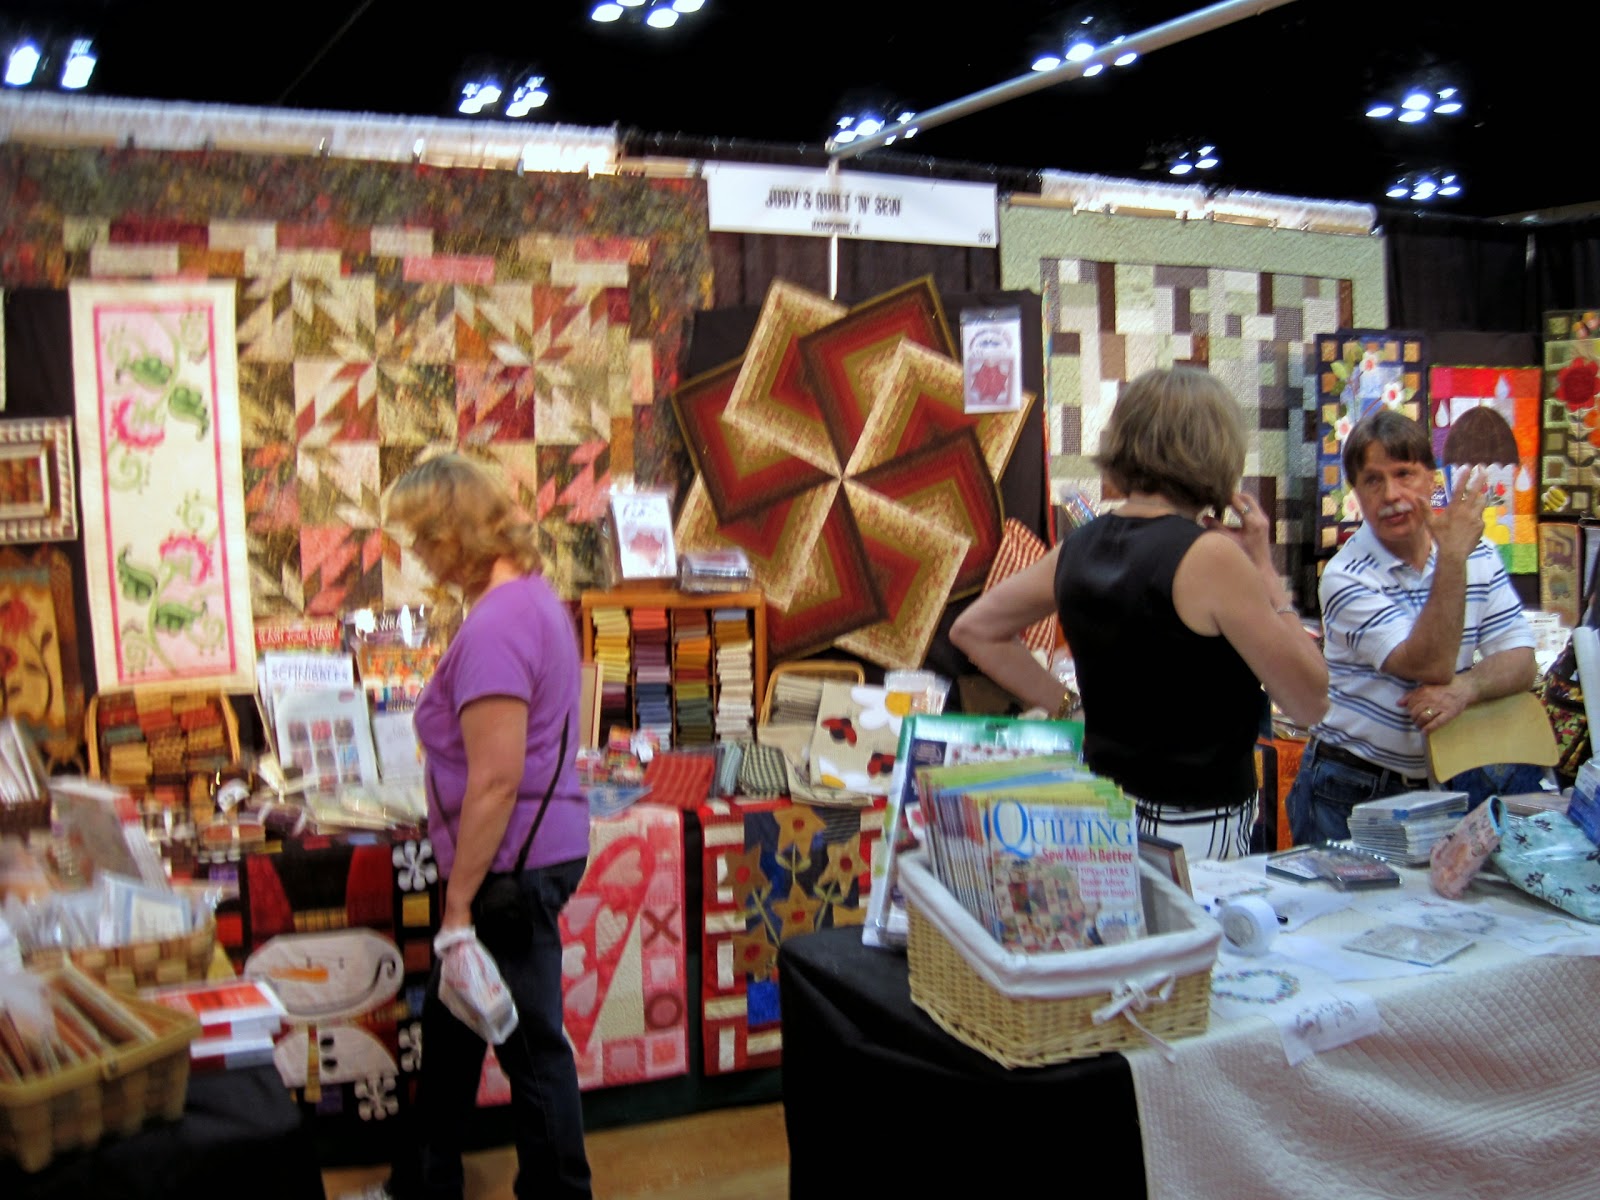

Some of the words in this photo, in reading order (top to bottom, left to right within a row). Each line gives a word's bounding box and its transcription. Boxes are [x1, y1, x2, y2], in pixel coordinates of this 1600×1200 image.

[765, 188, 811, 210] JUDY'S
[815, 191, 850, 212] QUILT
[874, 195, 901, 216] SEW
[993, 799, 1133, 860] QUILTING
[1042, 848, 1064, 864] Sew
[1065, 849, 1097, 862] Much
[1099, 848, 1133, 863] Better
